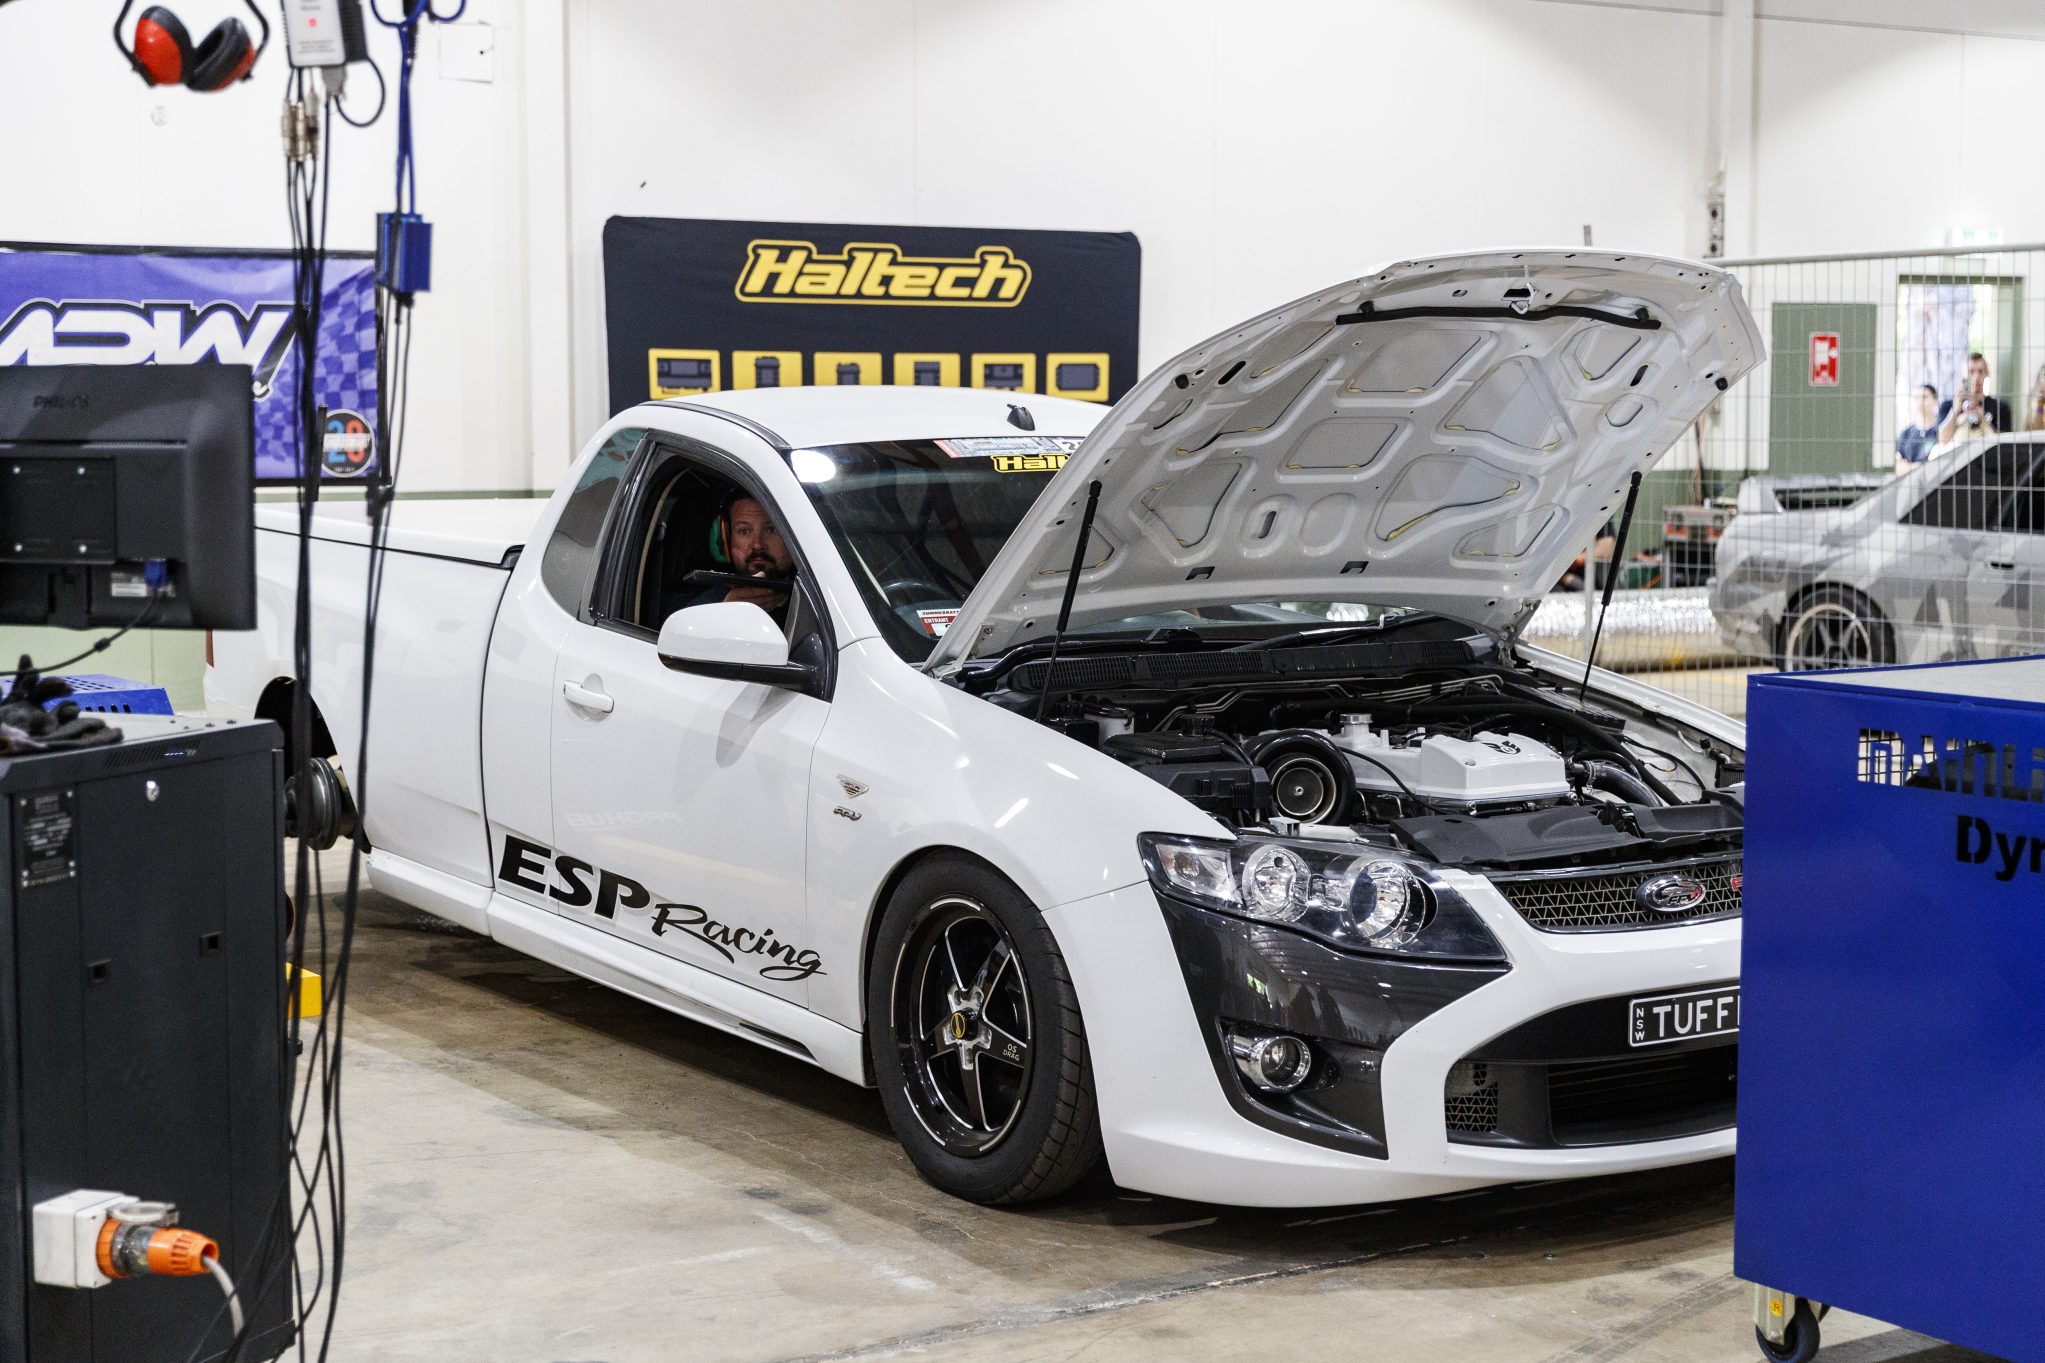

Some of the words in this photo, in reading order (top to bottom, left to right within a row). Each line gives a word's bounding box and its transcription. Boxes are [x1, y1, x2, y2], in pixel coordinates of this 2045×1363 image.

[744, 248, 1024, 299] Haltech
[498, 834, 651, 920] ESP
[651, 903, 828, 982] Racing
[1652, 996, 1741, 1038] TUFF
[1003, 1049, 1020, 1061] DRAG
[1007, 1043, 1018, 1053] OS
